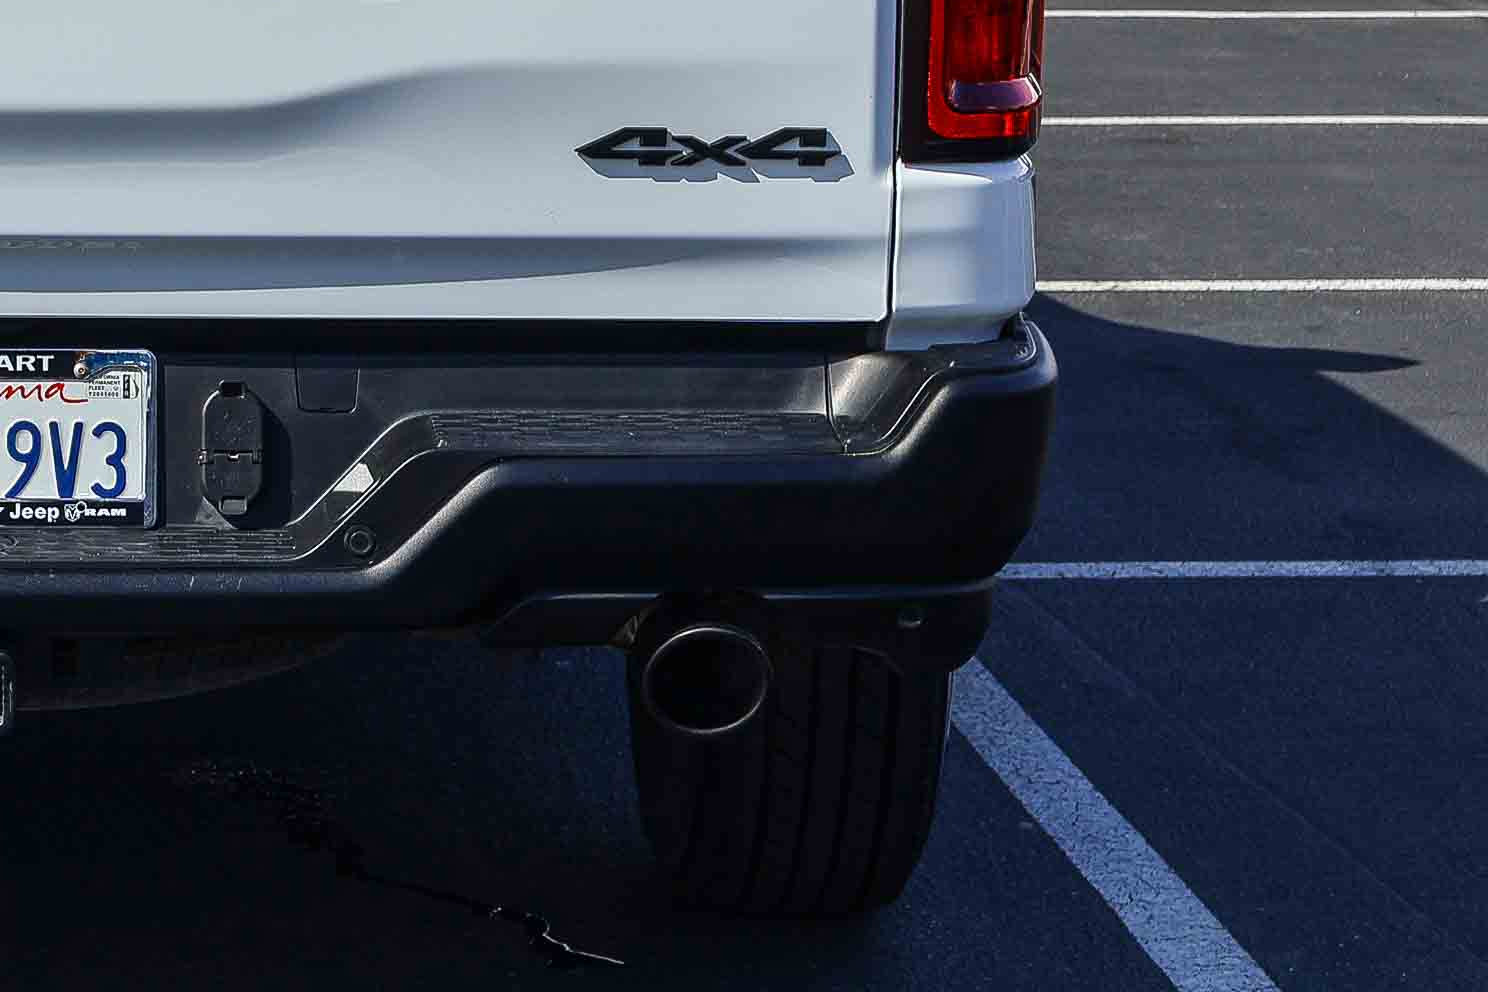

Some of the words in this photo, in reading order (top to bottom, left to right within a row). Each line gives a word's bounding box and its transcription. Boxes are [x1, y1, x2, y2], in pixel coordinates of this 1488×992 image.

[574, 125, 844, 168] 4x4
[9, 503, 60, 522] Jeep
[84, 508, 127, 517] RAM
